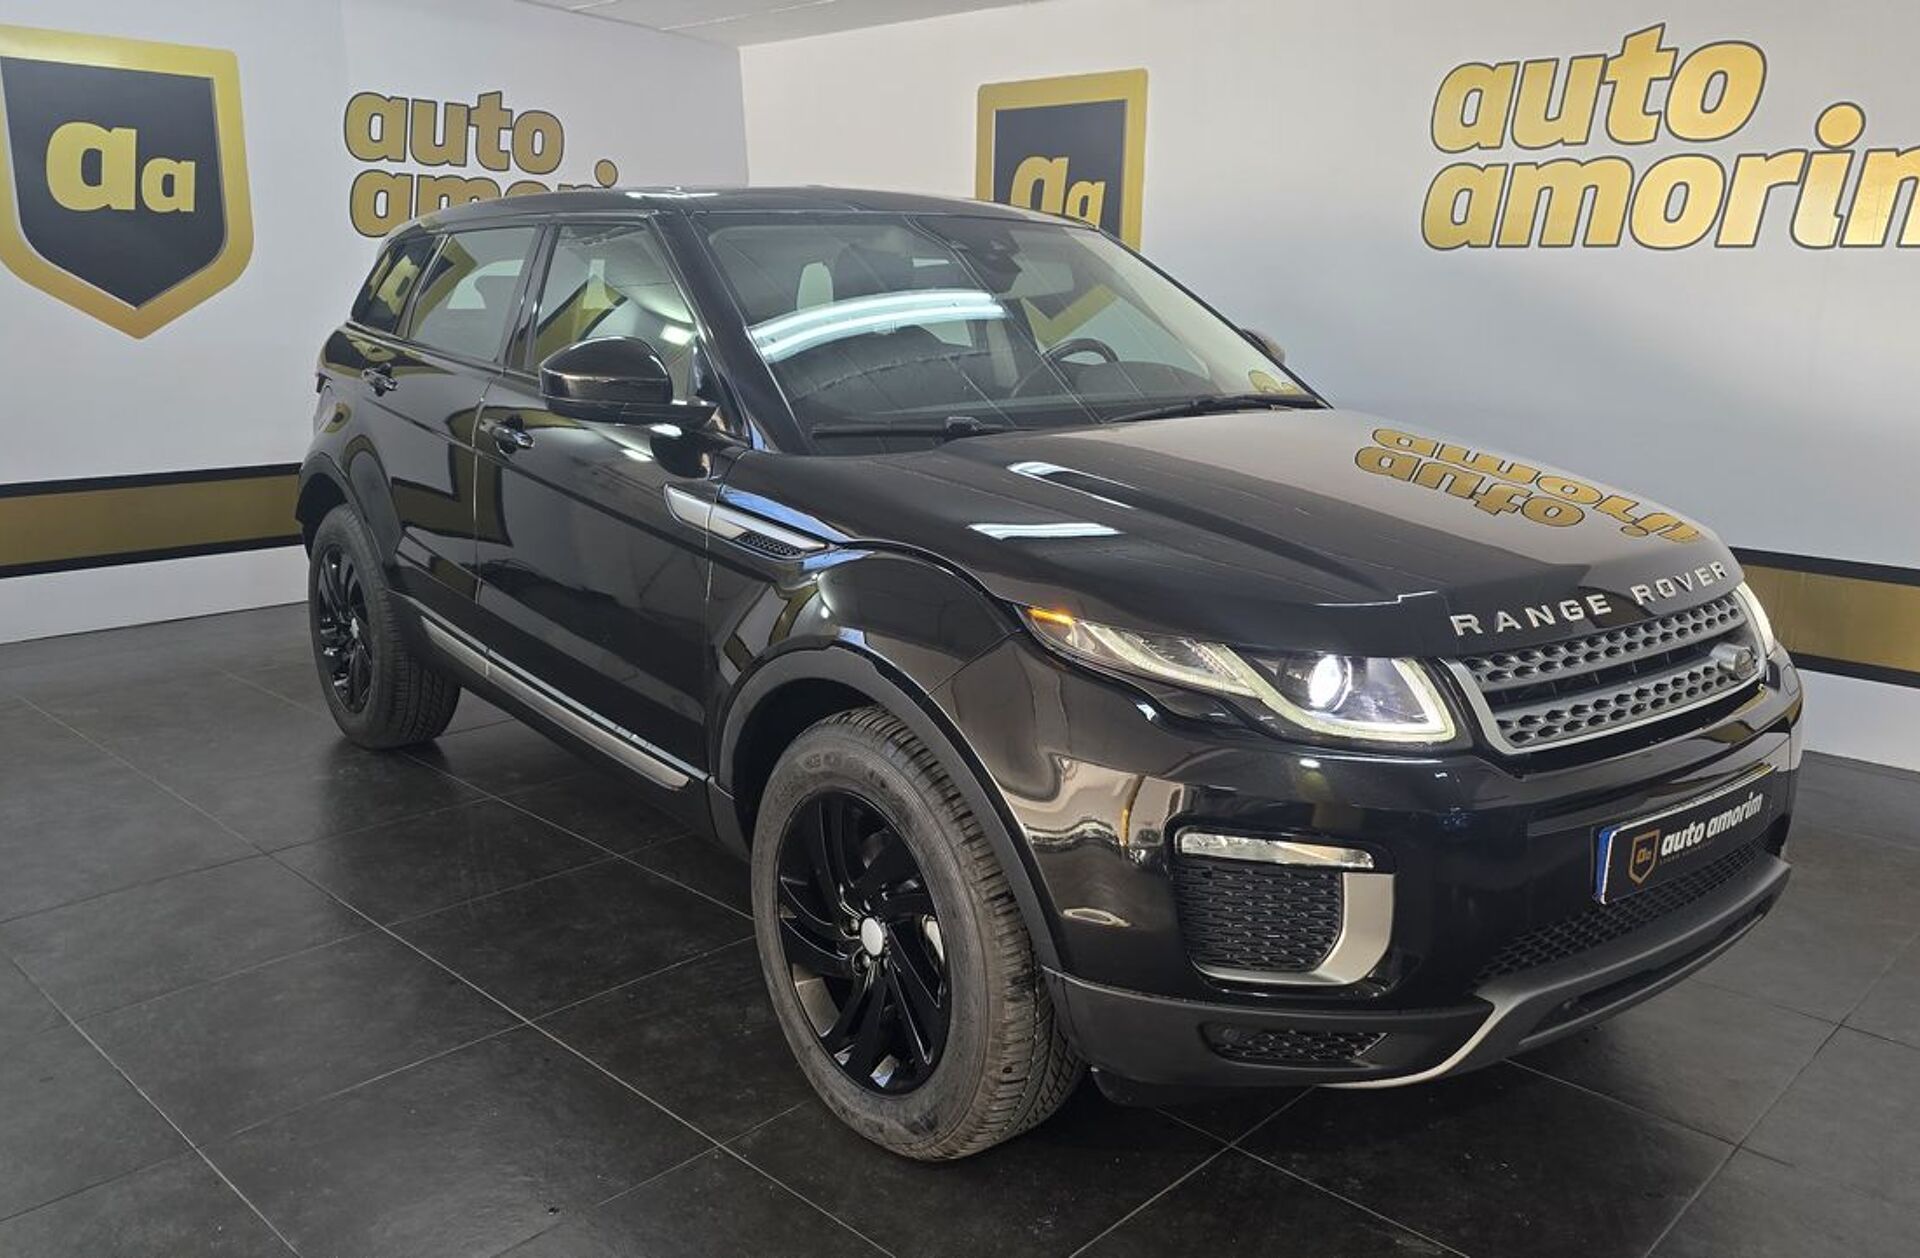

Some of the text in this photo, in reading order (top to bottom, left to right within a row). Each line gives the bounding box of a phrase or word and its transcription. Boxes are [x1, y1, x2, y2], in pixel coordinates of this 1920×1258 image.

[1430, 22, 1767, 153] auto
[344, 91, 564, 174] auto
[1450, 561, 1728, 636] RANGE ROVER
[1661, 821, 1705, 856] auto
[1707, 791, 1763, 838] amorim
